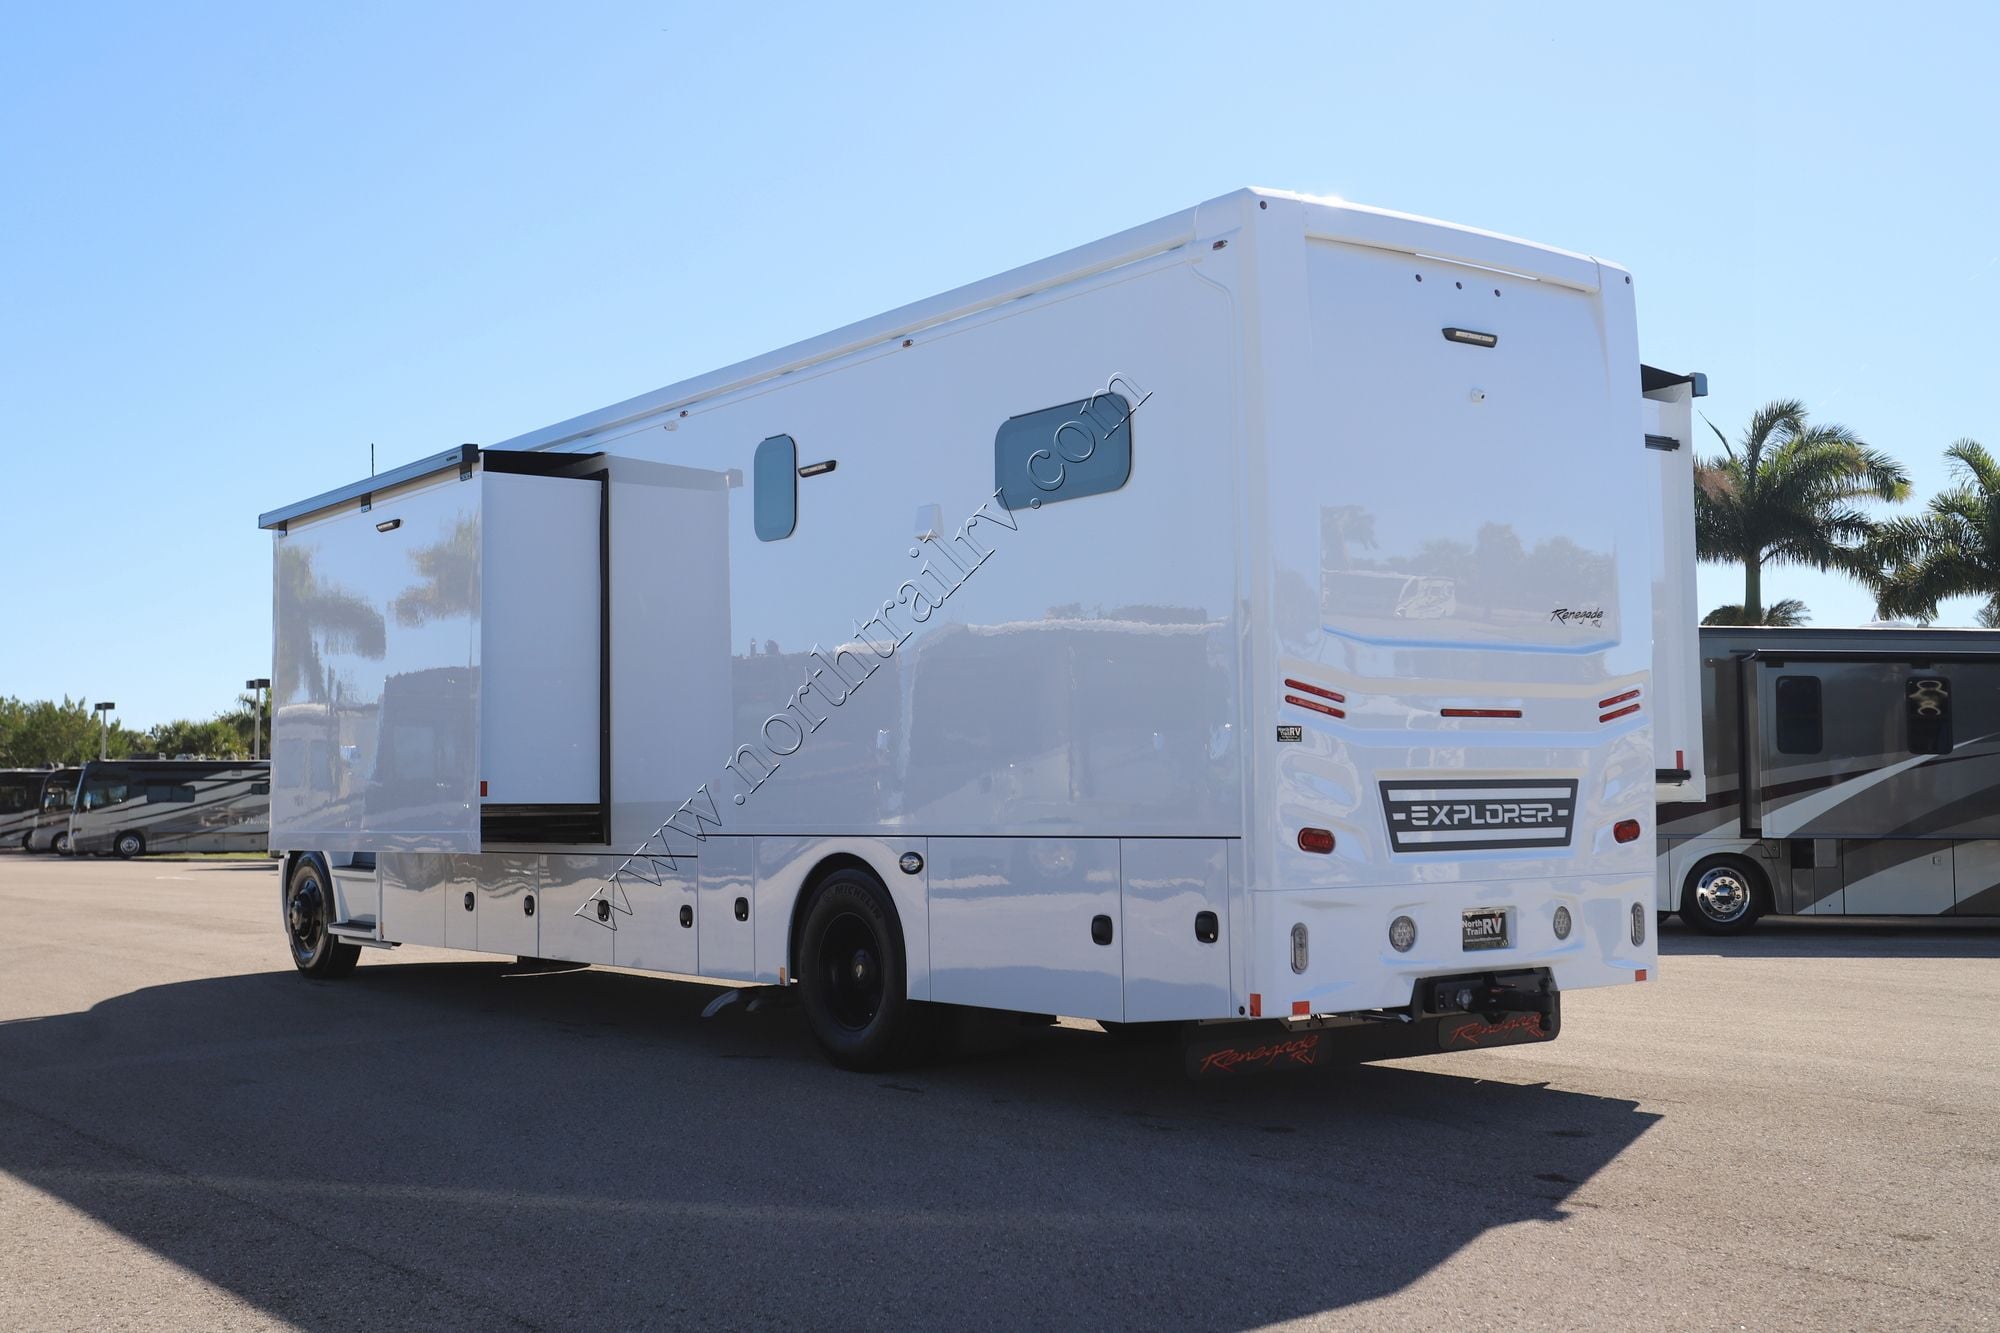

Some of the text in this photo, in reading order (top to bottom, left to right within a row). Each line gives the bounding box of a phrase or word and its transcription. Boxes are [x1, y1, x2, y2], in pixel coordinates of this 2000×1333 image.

[1550, 607, 1604, 624] Renegade
[1289, 727, 1301, 735] RV
[1410, 802, 1554, 827] EXPLORER
[834, 885, 881, 919] MICHELIN
[1461, 918, 1483, 928] North
[1465, 917, 1502, 936] Trail RV
[1449, 1011, 1542, 1044] Renegad
[1200, 1034, 1319, 1073] Renegade
[1288, 1048, 1318, 1065] RV
